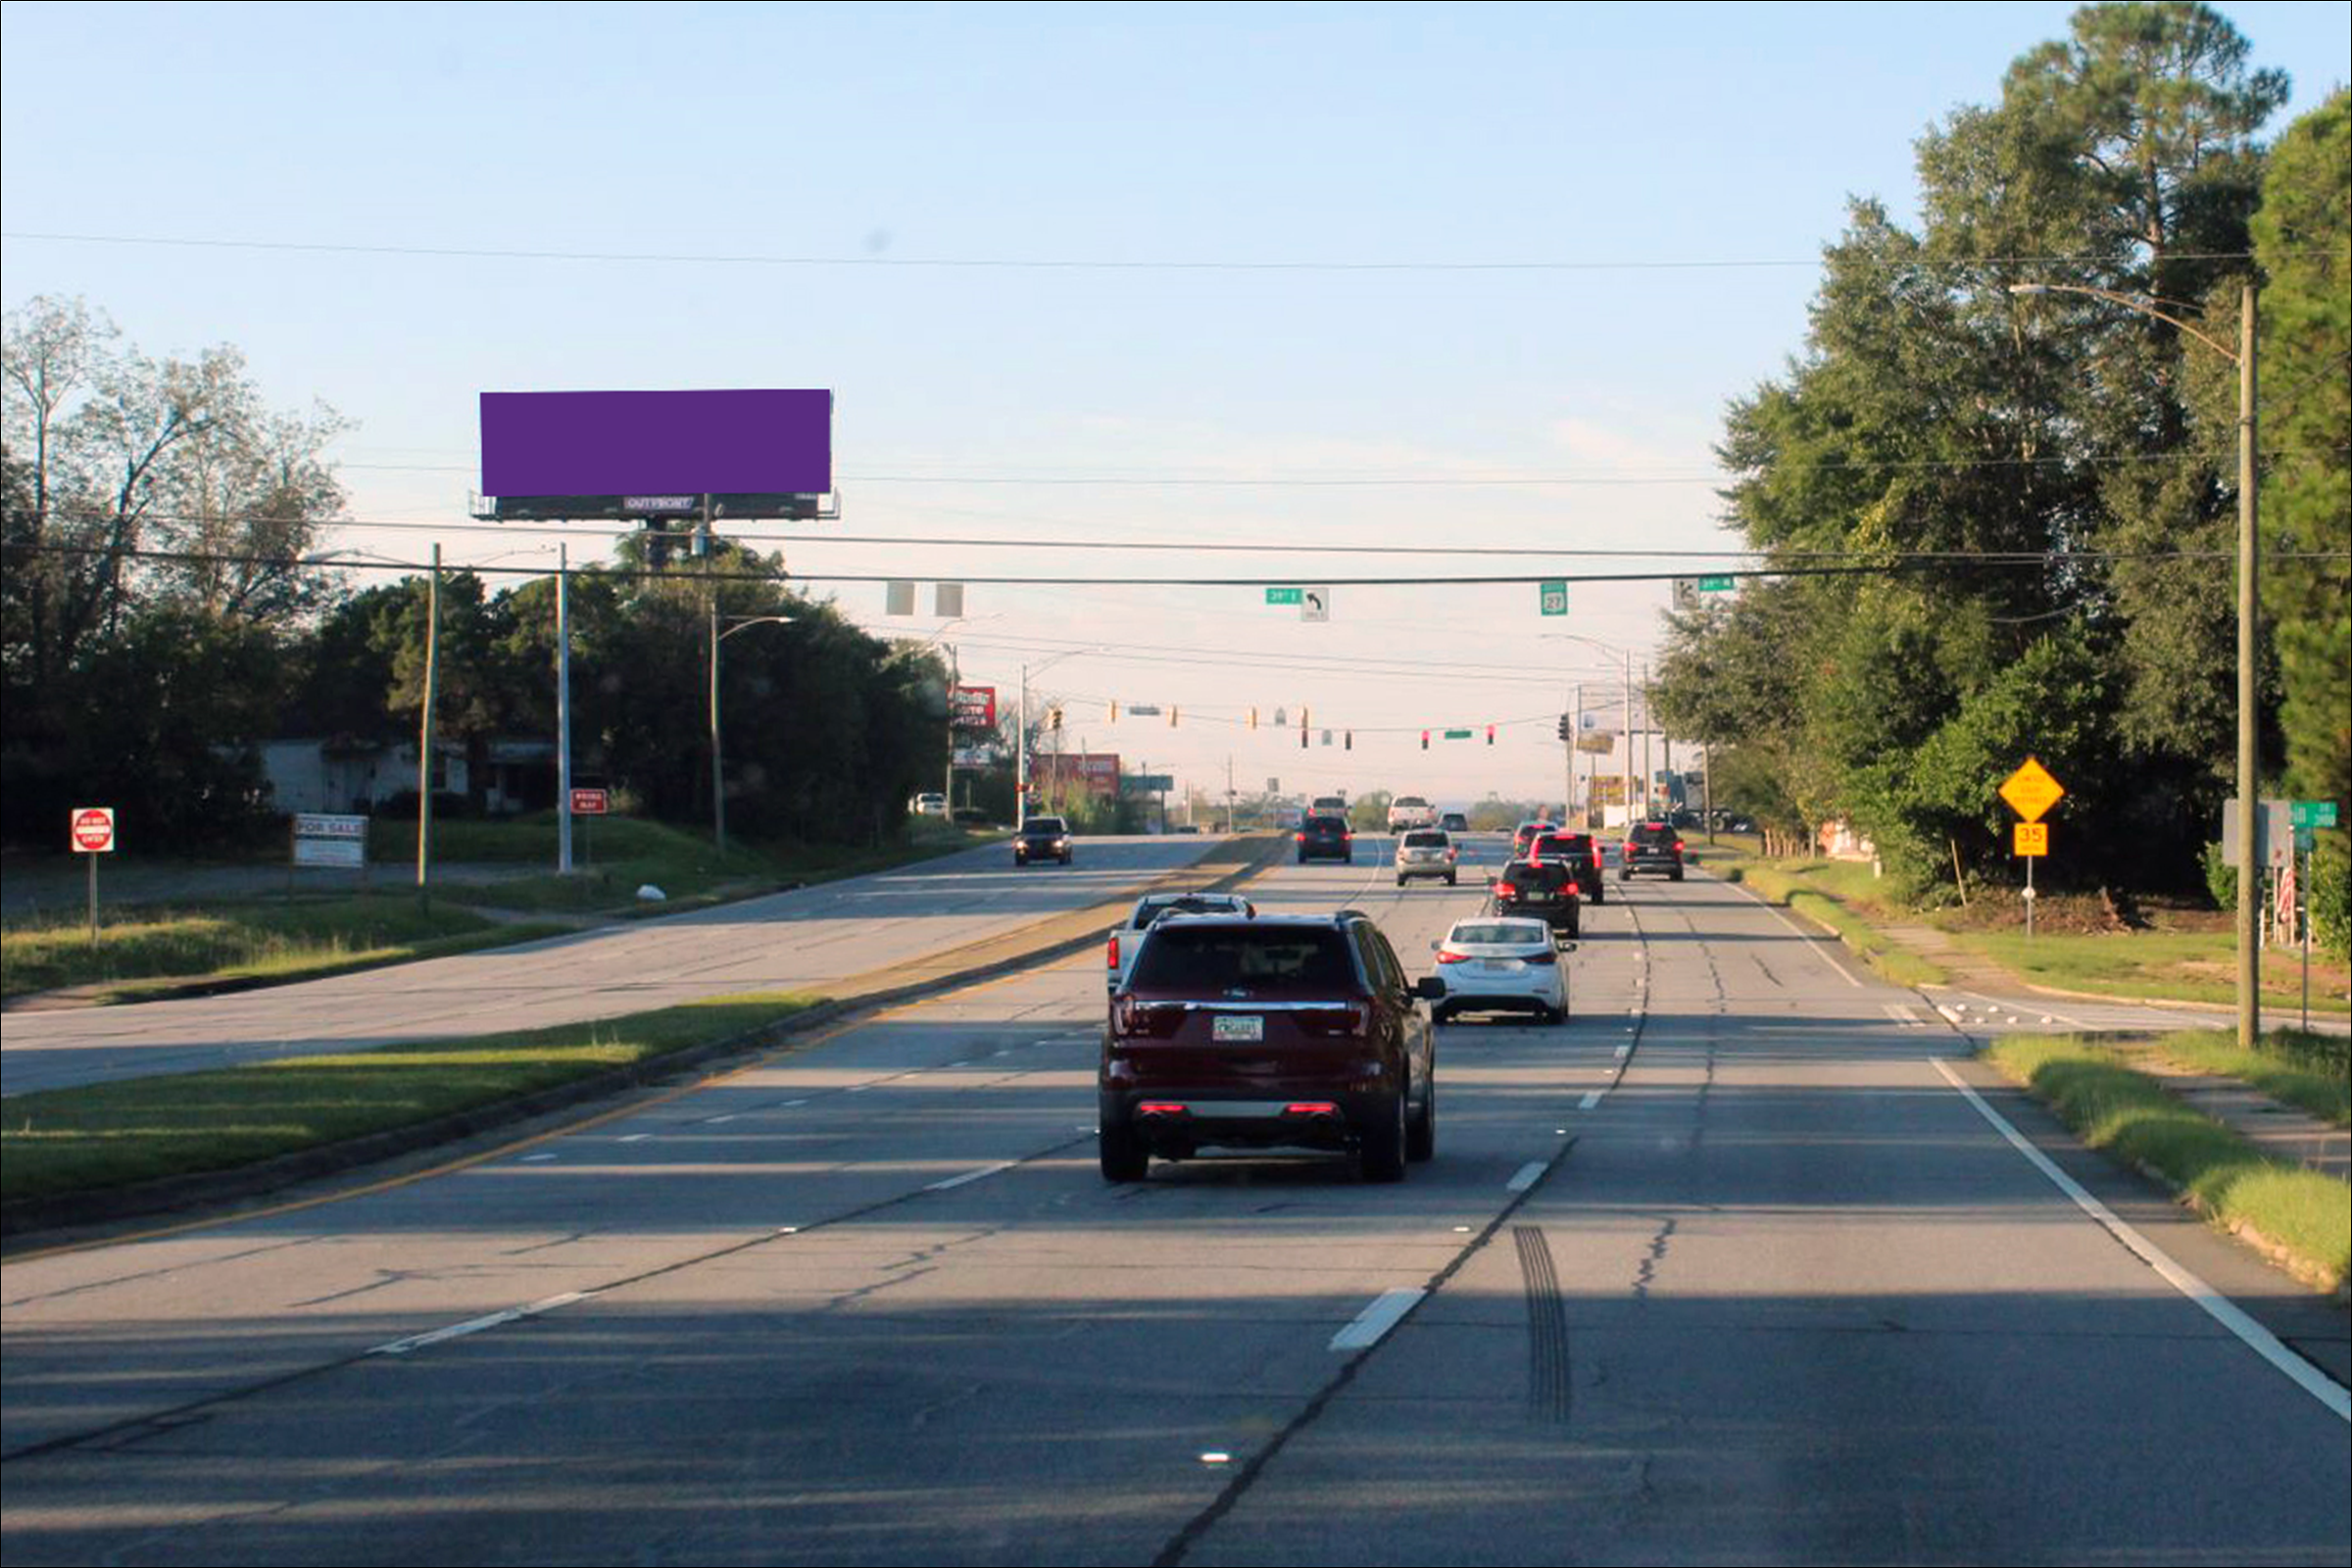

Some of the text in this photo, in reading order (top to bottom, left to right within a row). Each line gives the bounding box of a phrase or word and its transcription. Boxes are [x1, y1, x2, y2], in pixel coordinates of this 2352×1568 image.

[1546, 596, 1561, 609] 27
[298, 822, 365, 835] FOR SALE
[2019, 828, 2043, 842] 35
